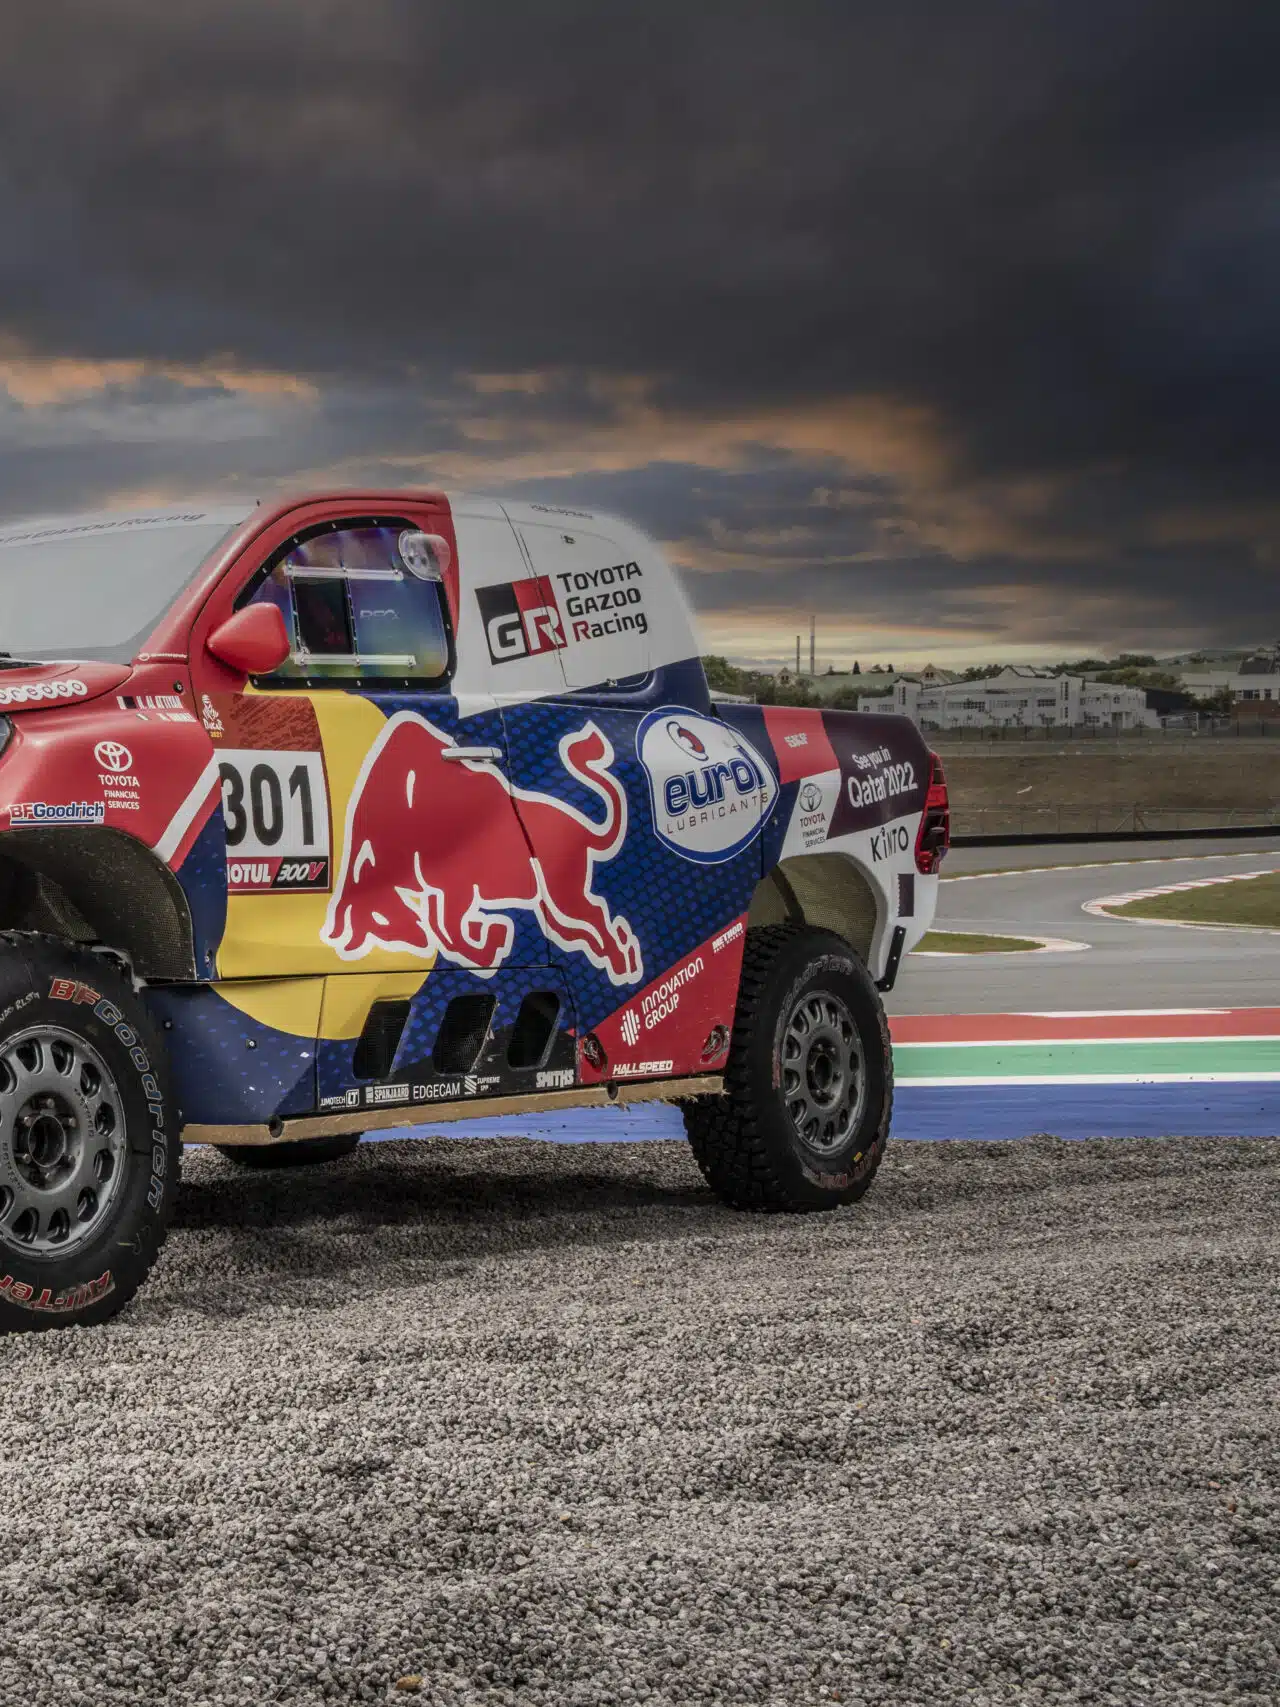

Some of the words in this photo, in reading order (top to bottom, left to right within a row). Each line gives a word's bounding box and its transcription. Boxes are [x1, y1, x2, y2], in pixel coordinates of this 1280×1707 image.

[557, 561, 642, 593] TOYOTA
[566, 588, 641, 618] GAZOO
[487, 605, 564, 659] GR
[572, 612, 648, 642] Racing
[852, 753, 870, 770] See
[869, 750, 882, 769] you
[880, 745, 891, 762] in
[98, 774, 140, 787] TOYOTA
[663, 745, 767, 818] eurol
[847, 774, 887, 808] Qatar
[885, 761, 918, 796] 2022
[104, 790, 140, 799] FINANCIAL
[108, 800, 140, 810] SERVICES
[218, 762, 314, 846] 301
[10, 802, 104, 819] BFGoodrich
[666, 792, 769, 835] LUBRICANTS
[800, 812, 826, 828] TOYOTA
[802, 827, 826, 838] FINANCIAL
[805, 836, 827, 848] SERVICES
[277, 861, 326, 881] 300V
[645, 993, 680, 1029] GROUP
[612, 1060, 673, 1076] HALLSPEED
[48, 977, 166, 1208] BFGoodrich
[374, 1087, 409, 1100] SPANJAARD
[413, 1083, 461, 1099] EDGECAM
